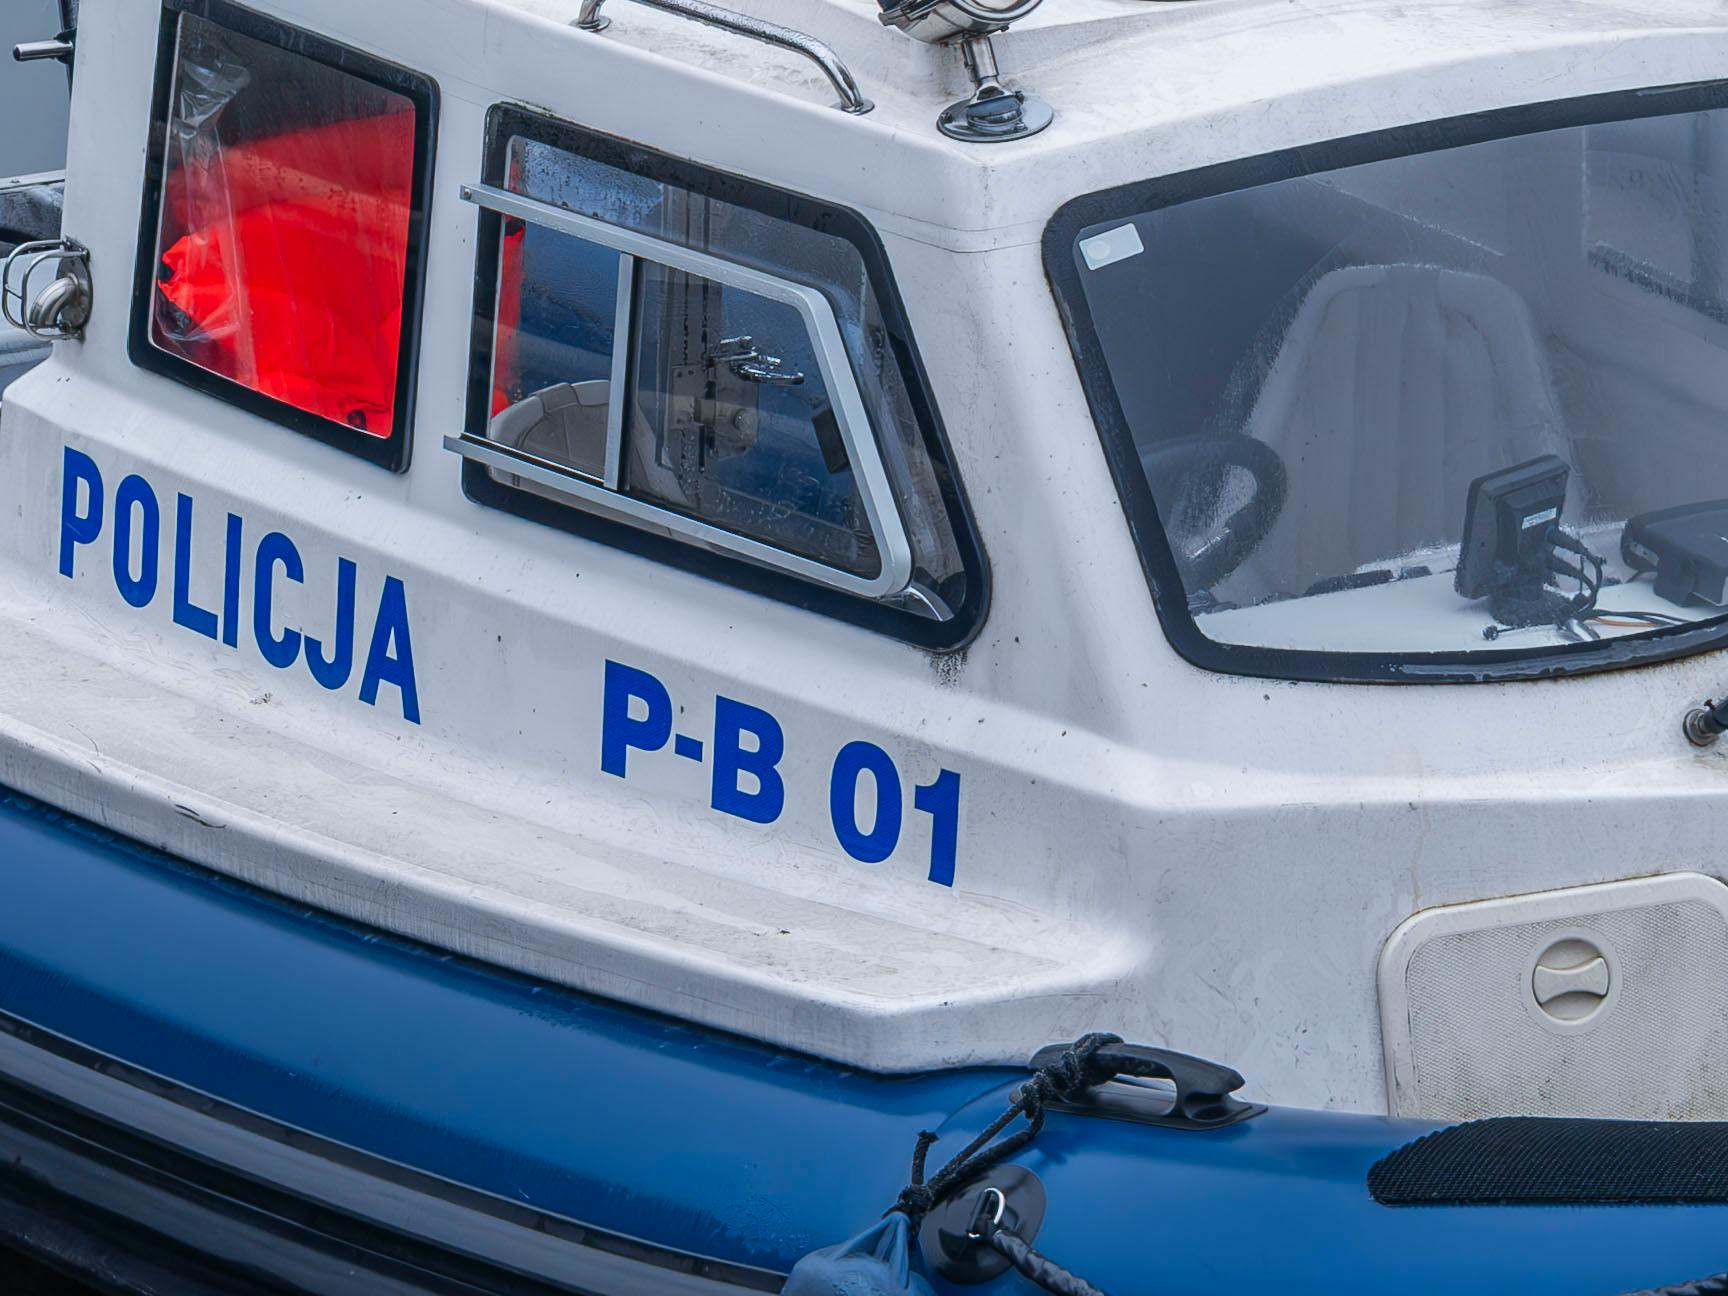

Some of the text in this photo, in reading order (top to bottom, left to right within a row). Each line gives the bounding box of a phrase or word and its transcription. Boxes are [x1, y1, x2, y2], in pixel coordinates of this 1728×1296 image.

[57, 445, 422, 726] POLICJA
[599, 658, 962, 889] P-B 01
